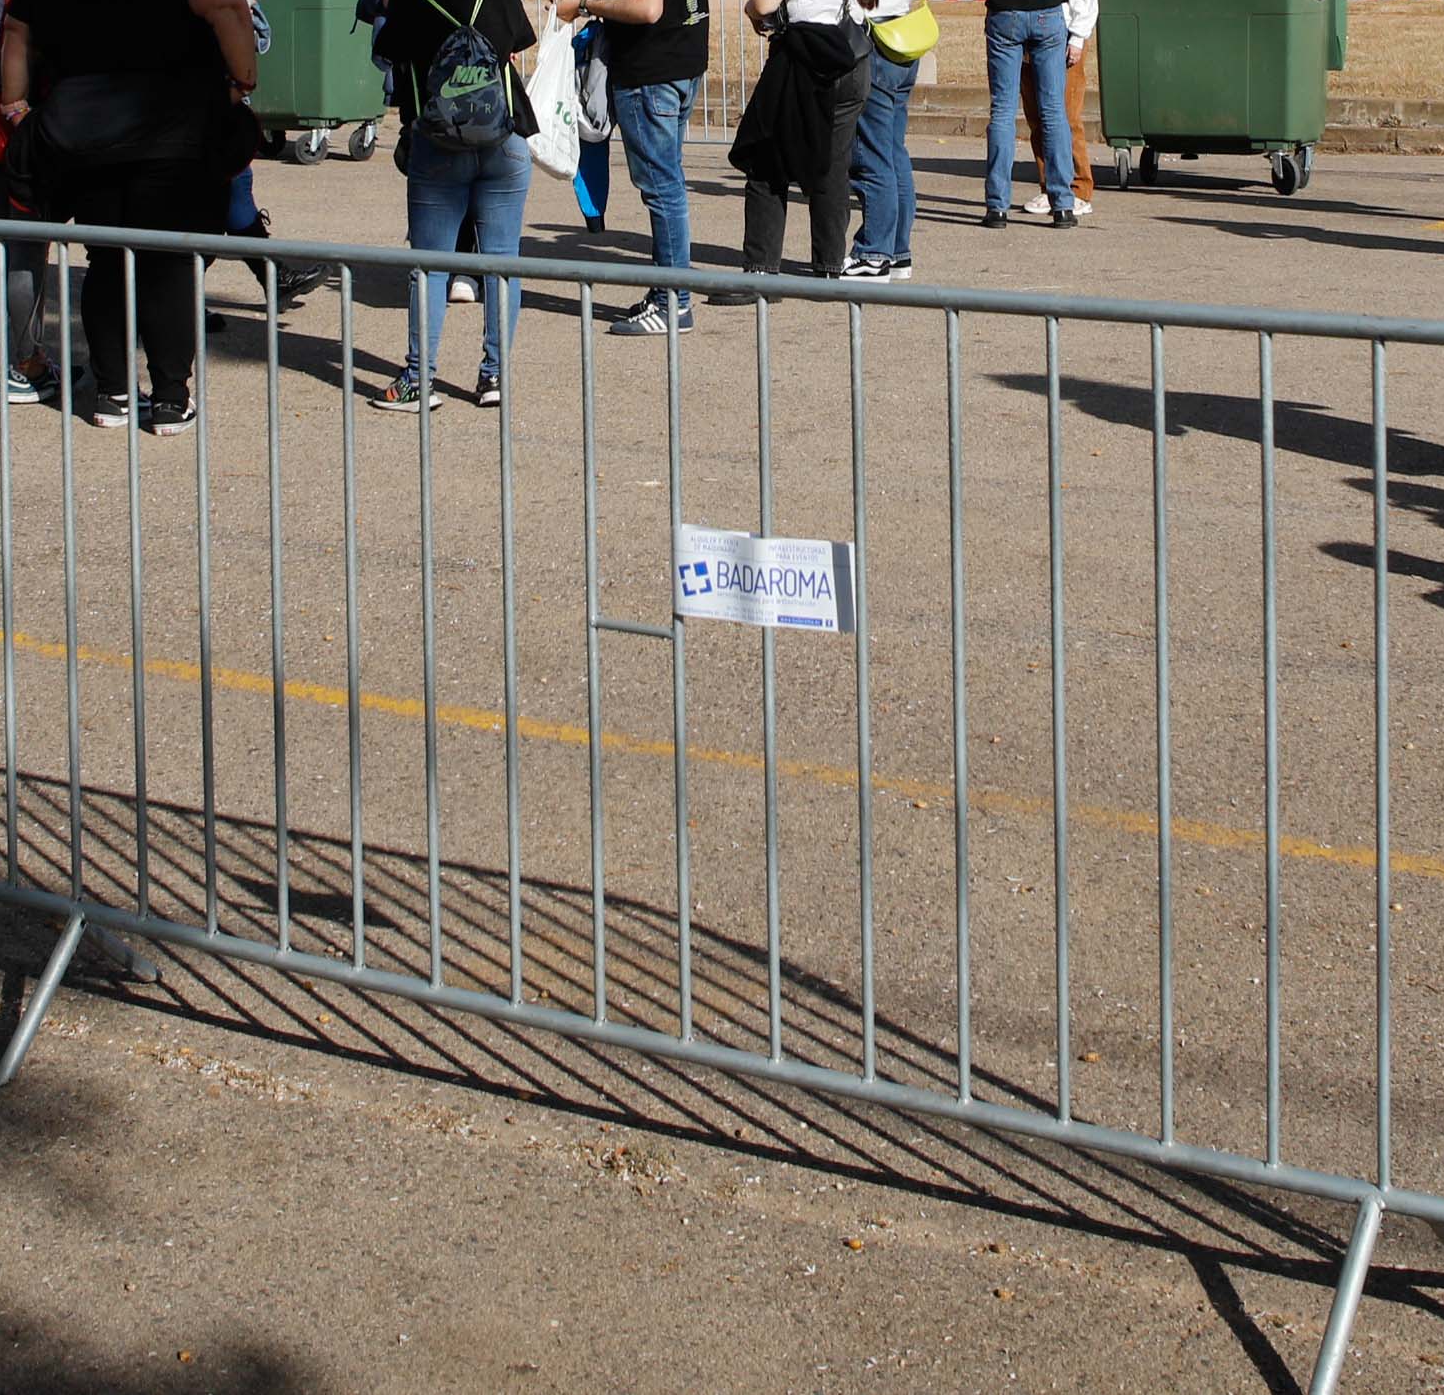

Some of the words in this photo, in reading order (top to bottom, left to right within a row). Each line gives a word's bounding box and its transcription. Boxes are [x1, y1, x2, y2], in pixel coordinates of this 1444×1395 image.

[450, 65, 490, 85] NIKE
[448, 102, 494, 115] AIR
[716, 560, 832, 601] BADAROMA
